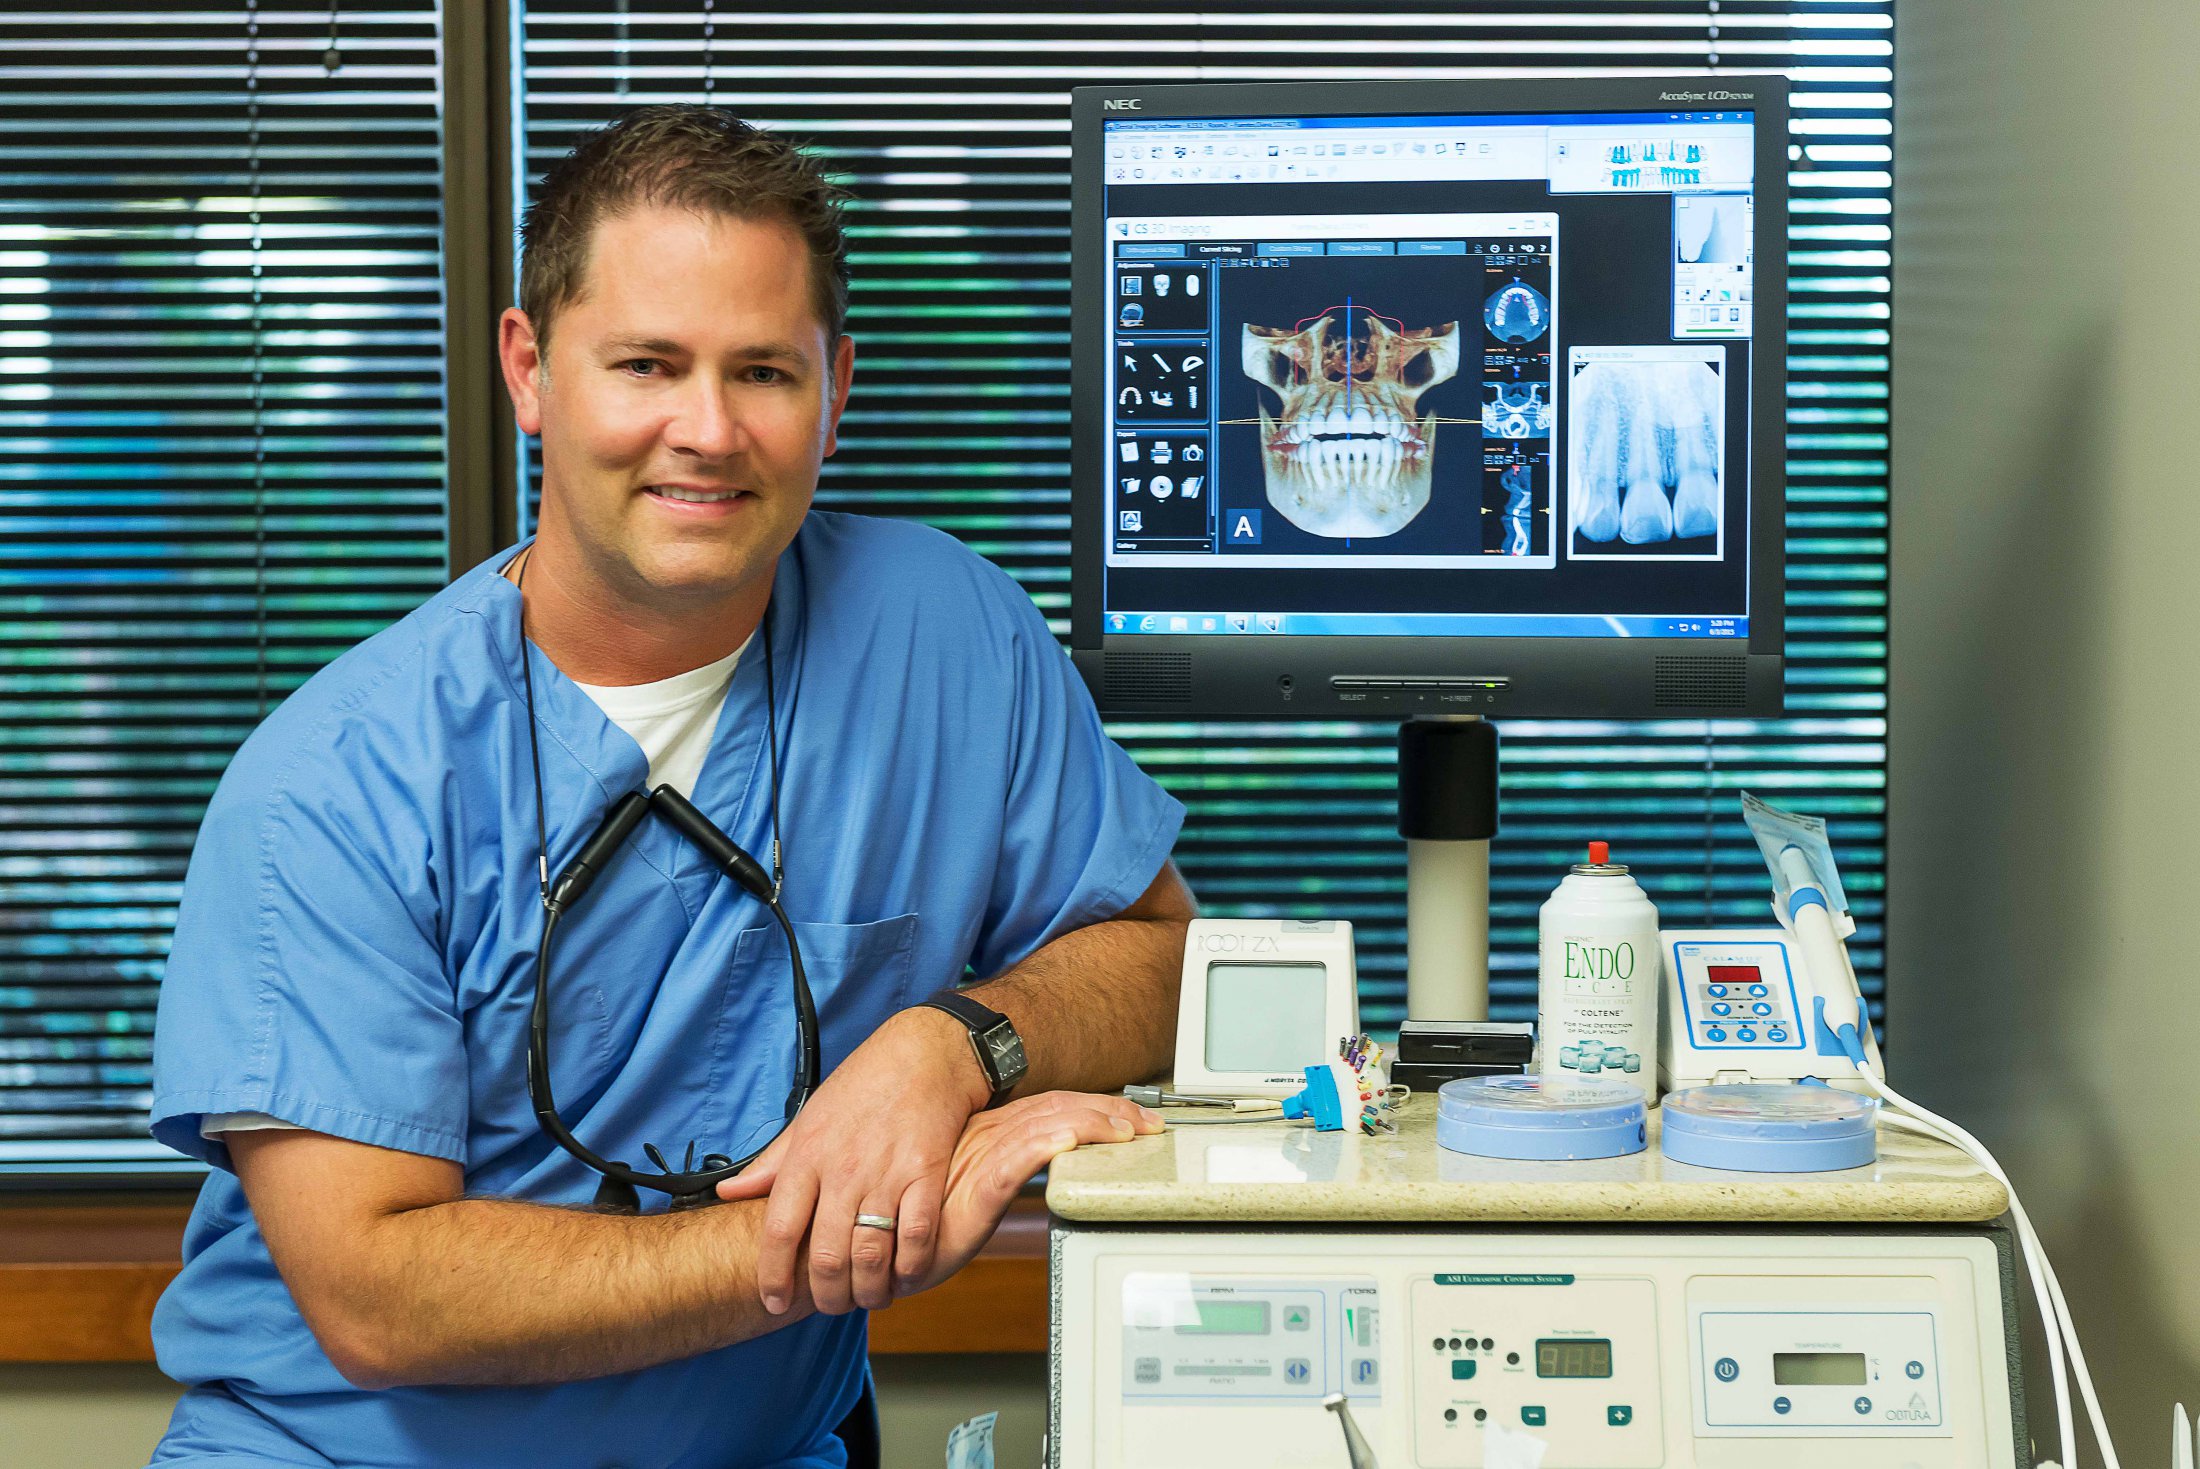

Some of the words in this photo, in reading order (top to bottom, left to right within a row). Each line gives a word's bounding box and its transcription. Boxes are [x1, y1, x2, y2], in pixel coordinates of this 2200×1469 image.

[1659, 91, 1706, 103] AccuSync
[1104, 98, 1142, 110] NEC
[1134, 223, 1148, 234] CS
[1233, 515, 1255, 538] A
[1252, 936, 1279, 952] ZX
[1563, 942, 1635, 980] ENDO
[1581, 1009, 1621, 1017] COLTENE
[1909, 1366, 1921, 1375] M
[1885, 1410, 1932, 1421] OBTURA
